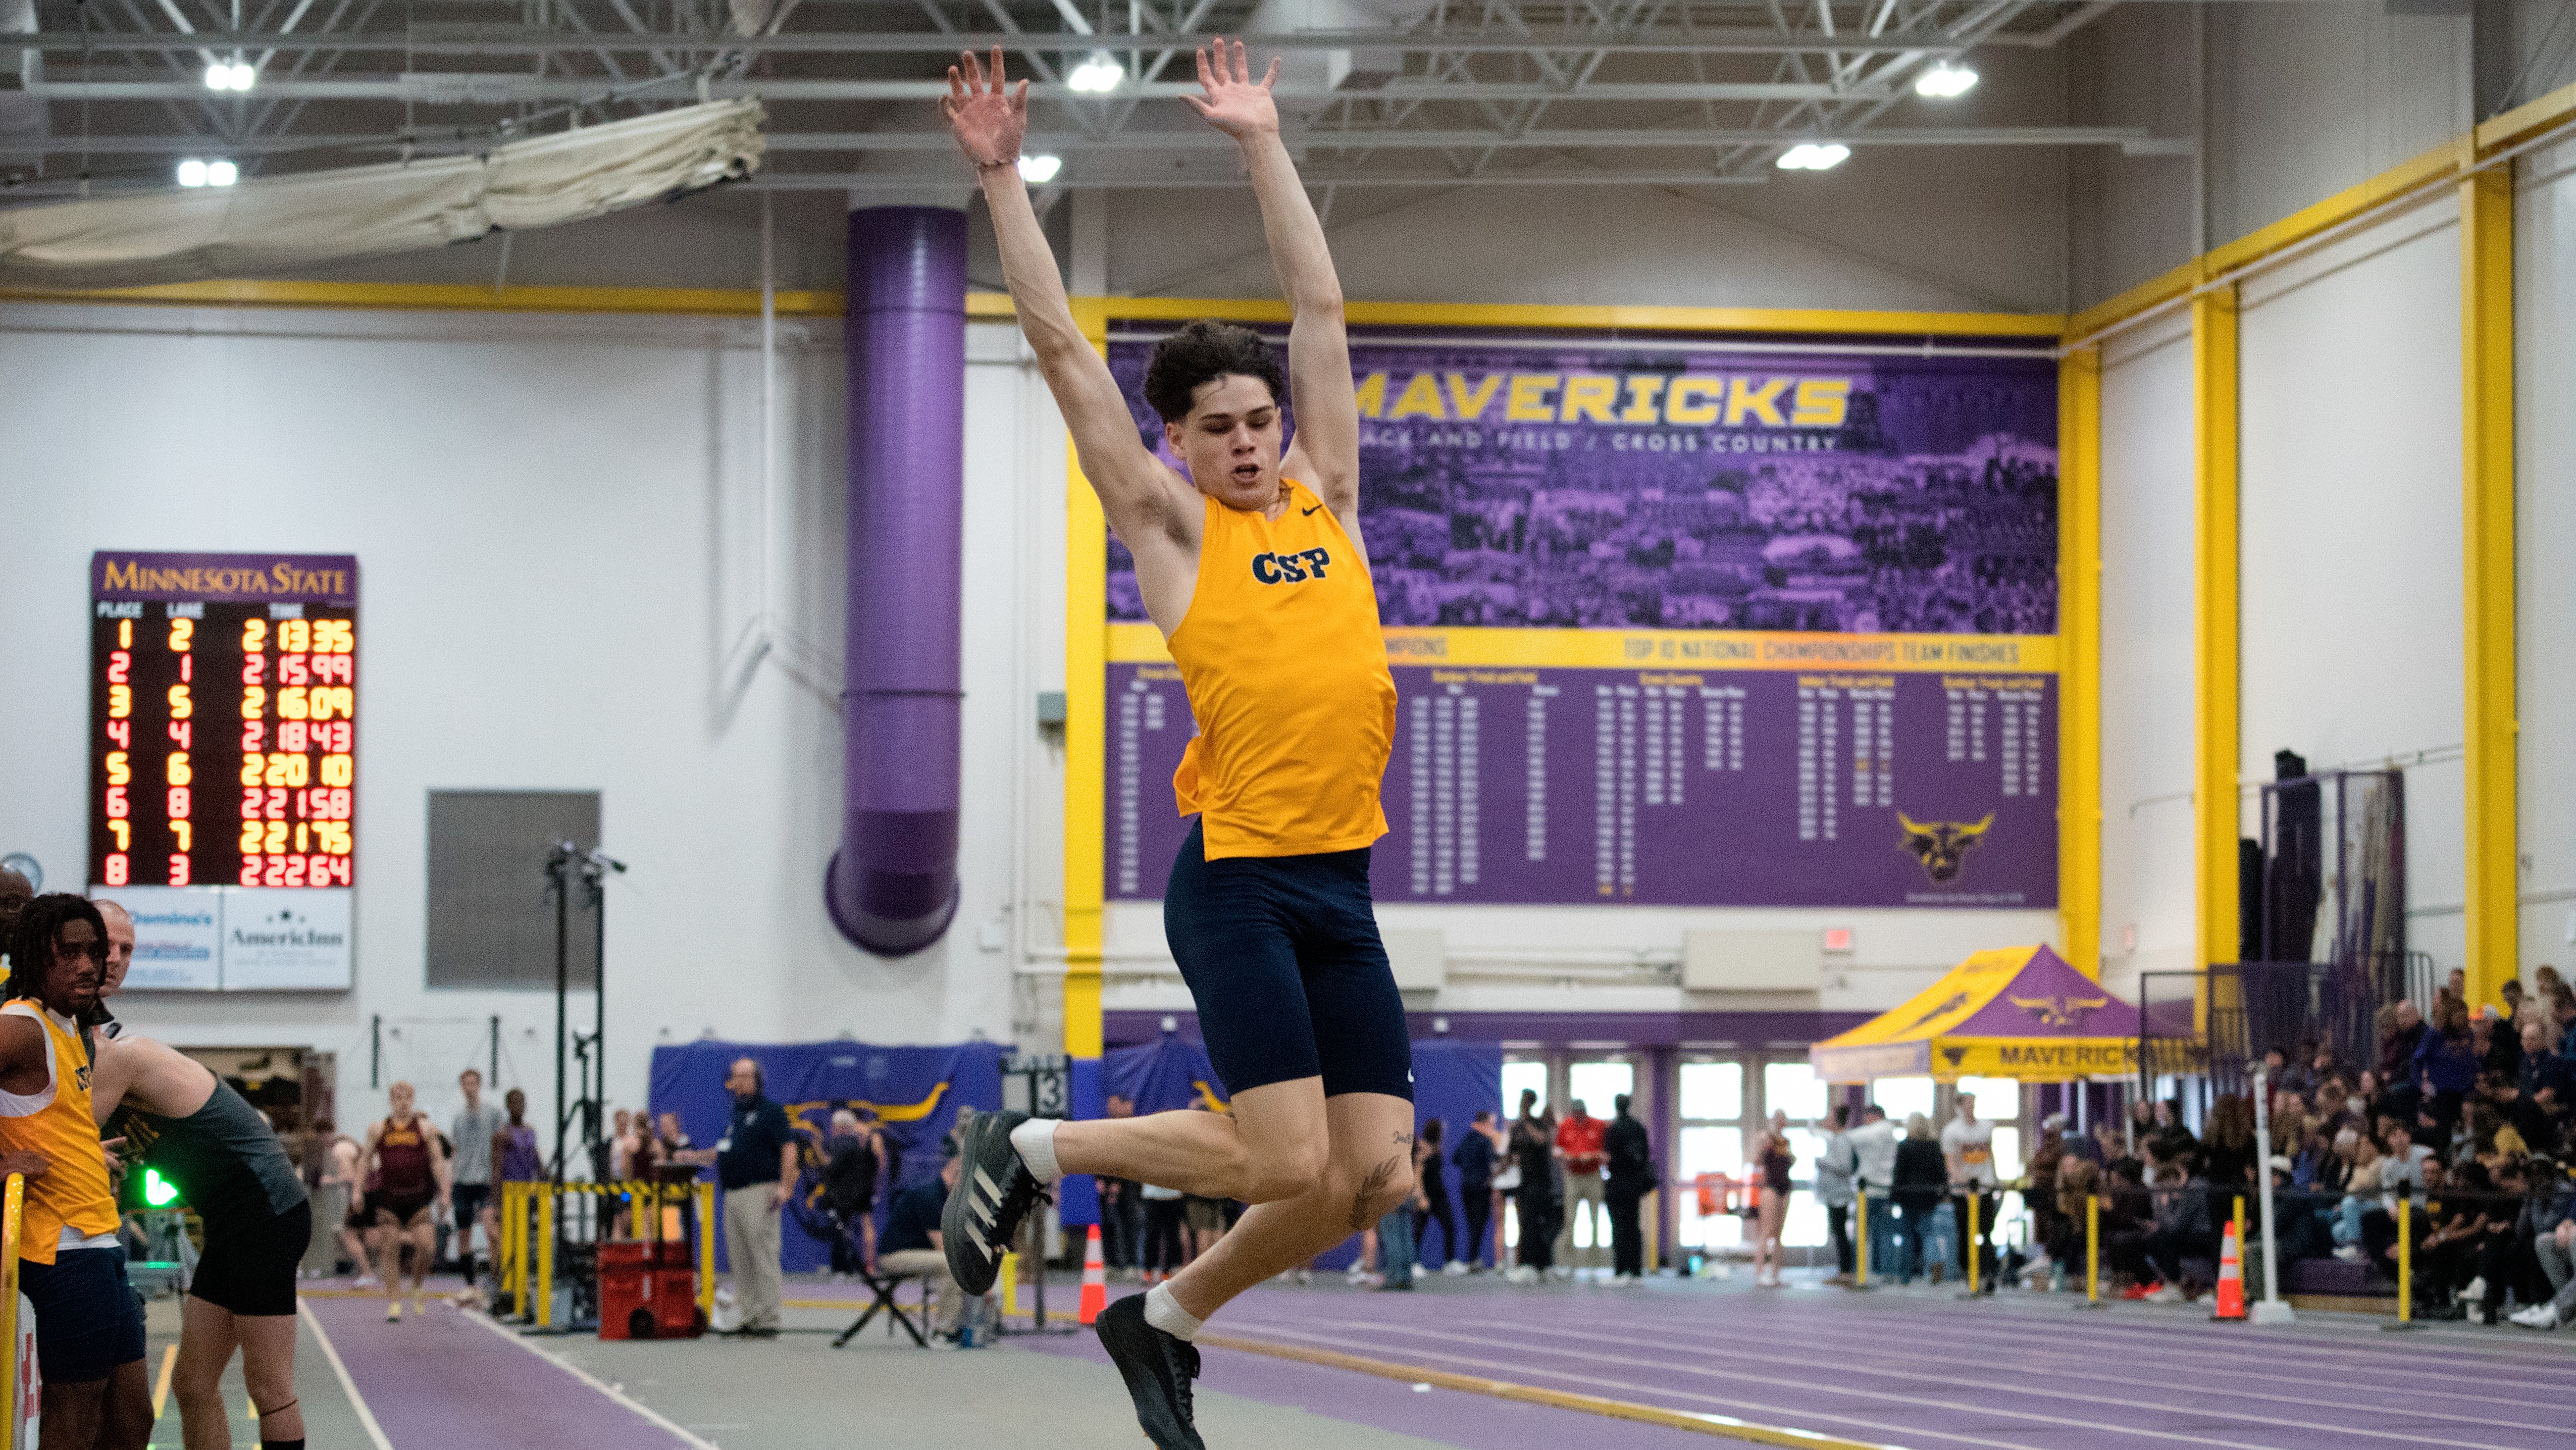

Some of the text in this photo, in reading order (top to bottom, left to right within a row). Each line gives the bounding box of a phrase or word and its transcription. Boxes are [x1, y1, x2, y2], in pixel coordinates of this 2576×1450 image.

[1362, 432, 1411, 449] ACK
[1429, 432, 1482, 449] AND
[1498, 433, 1572, 450] FIELD
[1612, 434, 1698, 452] CROSS
[1712, 434, 1836, 453] COUNTRY
[104, 560, 345, 594] MINNESOTA STATE
[1251, 547, 1330, 585] CSP
[97, 602, 303, 619] PLACE LANE TIME
[119, 618, 132, 649] 1
[168, 618, 193, 652] 2
[108, 651, 130, 683] 2
[181, 653, 191, 683] 1
[109, 685, 131, 718] 3
[168, 685, 193, 719] 5
[107, 720, 130, 749] 4
[168, 720, 191, 750] 4
[106, 751, 131, 786] 5
[167, 752, 192, 787] 6
[106, 786, 130, 819] 6
[168, 786, 190, 819] 8
[108, 818, 131, 852] 7
[169, 819, 192, 852] 7
[105, 853, 128, 887] 8
[168, 854, 190, 887] 3
[1043, 1072, 1061, 1108] 3
